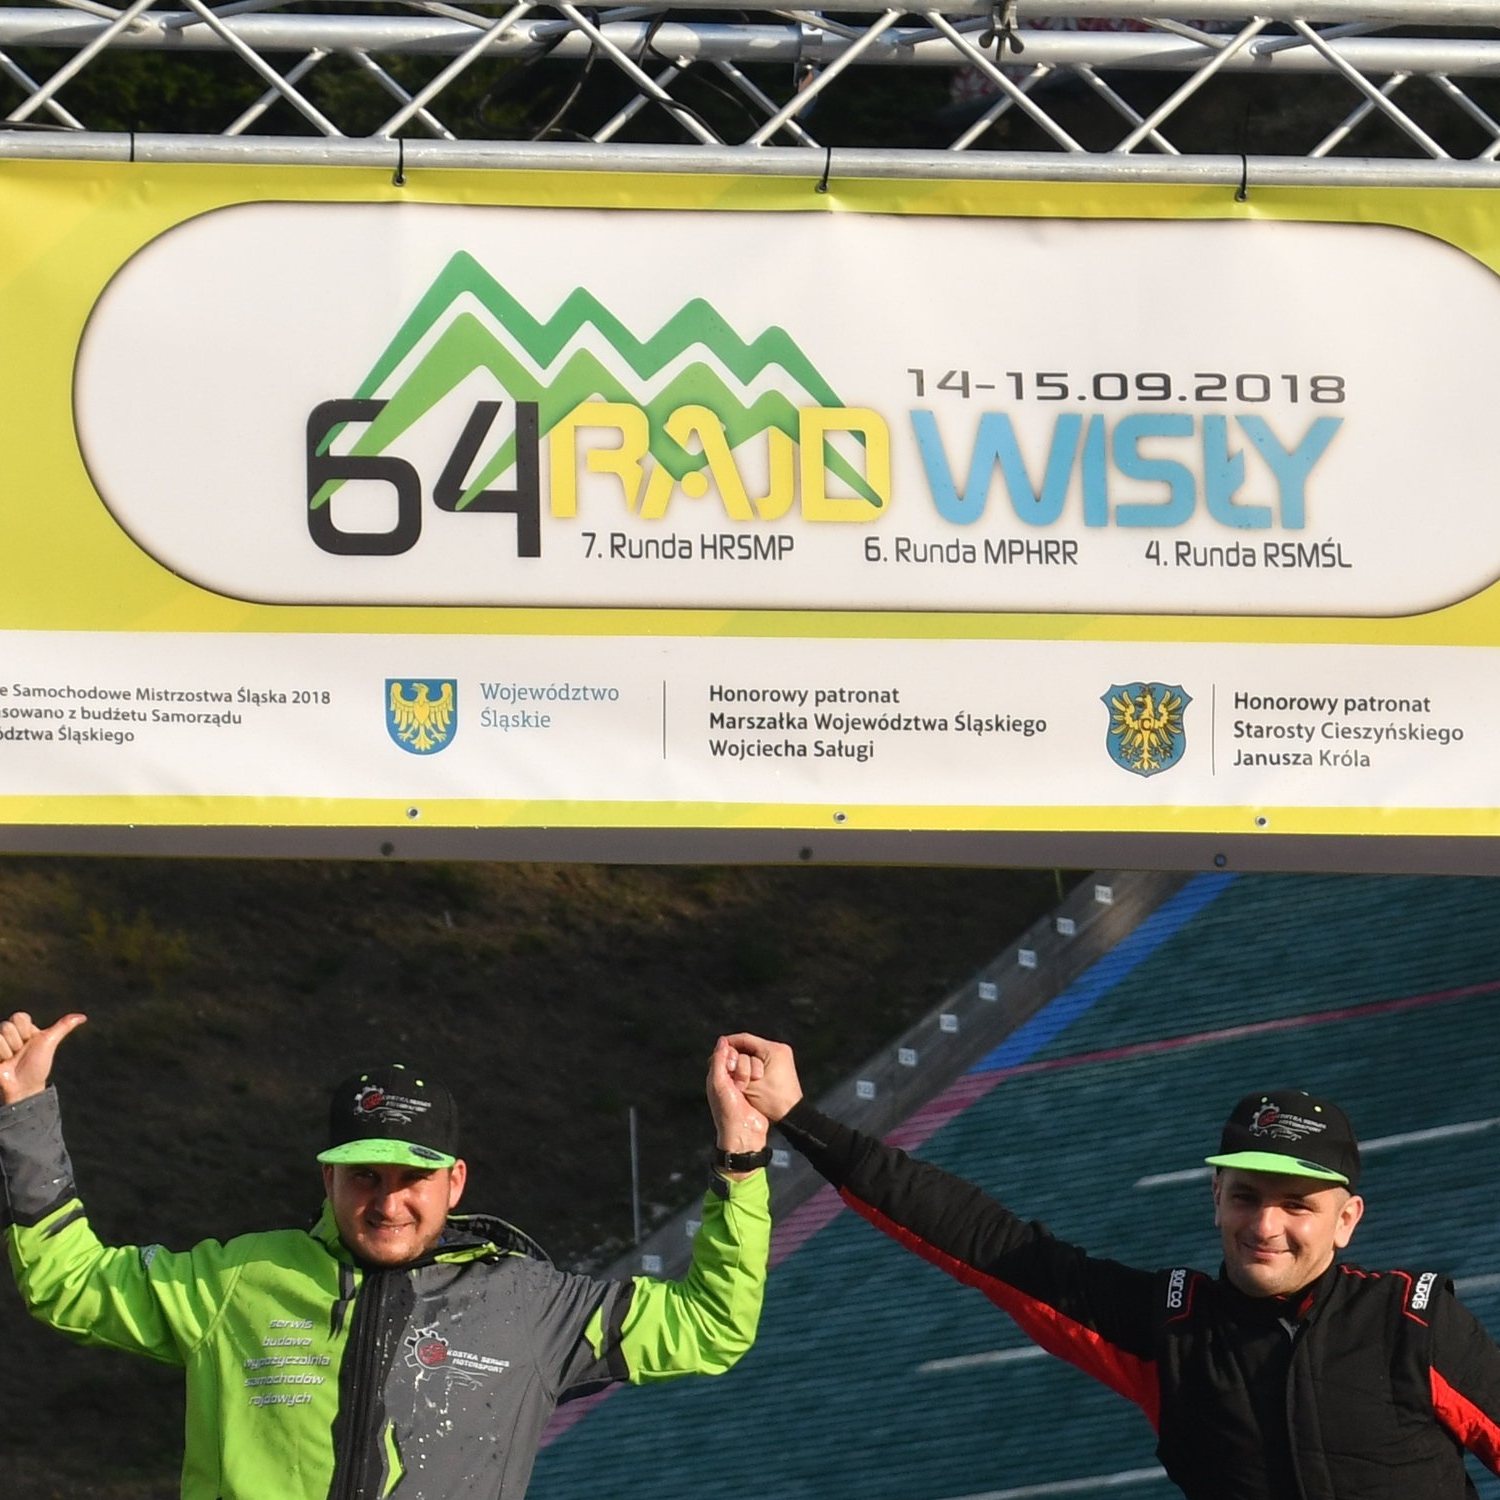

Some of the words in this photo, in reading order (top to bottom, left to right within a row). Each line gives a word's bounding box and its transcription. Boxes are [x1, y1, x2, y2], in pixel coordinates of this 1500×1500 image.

[906, 367, 1347, 405] 14-15.09.2018
[306, 399, 542, 559] 64
[550, 400, 891, 522] RAJD
[908, 409, 1346, 530] WISŁY
[581, 532, 603, 561] 7.
[609, 532, 693, 561] Runda
[700, 534, 795, 562] HRSMP
[864, 536, 889, 563] 6.
[895, 537, 977, 565] Runda
[983, 539, 1079, 566] MPHRR
[1145, 539, 1169, 567] 4.
[1175, 540, 1257, 567] Runda
[1264, 536, 1353, 569] RSMŚL
[12, 683, 132, 702] Samochodowe
[136, 685, 234, 704] Mistrzostwa
[236, 686, 288, 707] Śląska
[291, 689, 331, 705] 2018
[479, 682, 620, 705] Województwo
[708, 684, 809, 707] Honorowy
[813, 685, 900, 707] patronat
[1234, 691, 1338, 715] Honorowy
[1343, 694, 1432, 716] patronat
[67, 709, 78, 722] z
[80, 705, 148, 723] budżetu
[151, 708, 243, 728] Samorządu
[479, 708, 551, 732] Śląskie
[708, 710, 808, 732] Marszałka
[813, 710, 949, 734] Województwa
[954, 711, 1048, 738] Śląskiego
[57, 724, 136, 746] Śląskiego
[1233, 720, 1316, 743] Starosty
[1320, 721, 1464, 745] Cieszyńskiego
[708, 738, 808, 761] Wojciecha
[812, 738, 875, 763] Saługi
[1233, 748, 1314, 768] Janusza
[1318, 750, 1371, 768] Króla
[268, 1319, 313, 1330] serwis
[261, 1335, 312, 1347] budowa
[446, 1349, 478, 1361] KOSTKA
[249, 1392, 312, 1409] rajdowych
